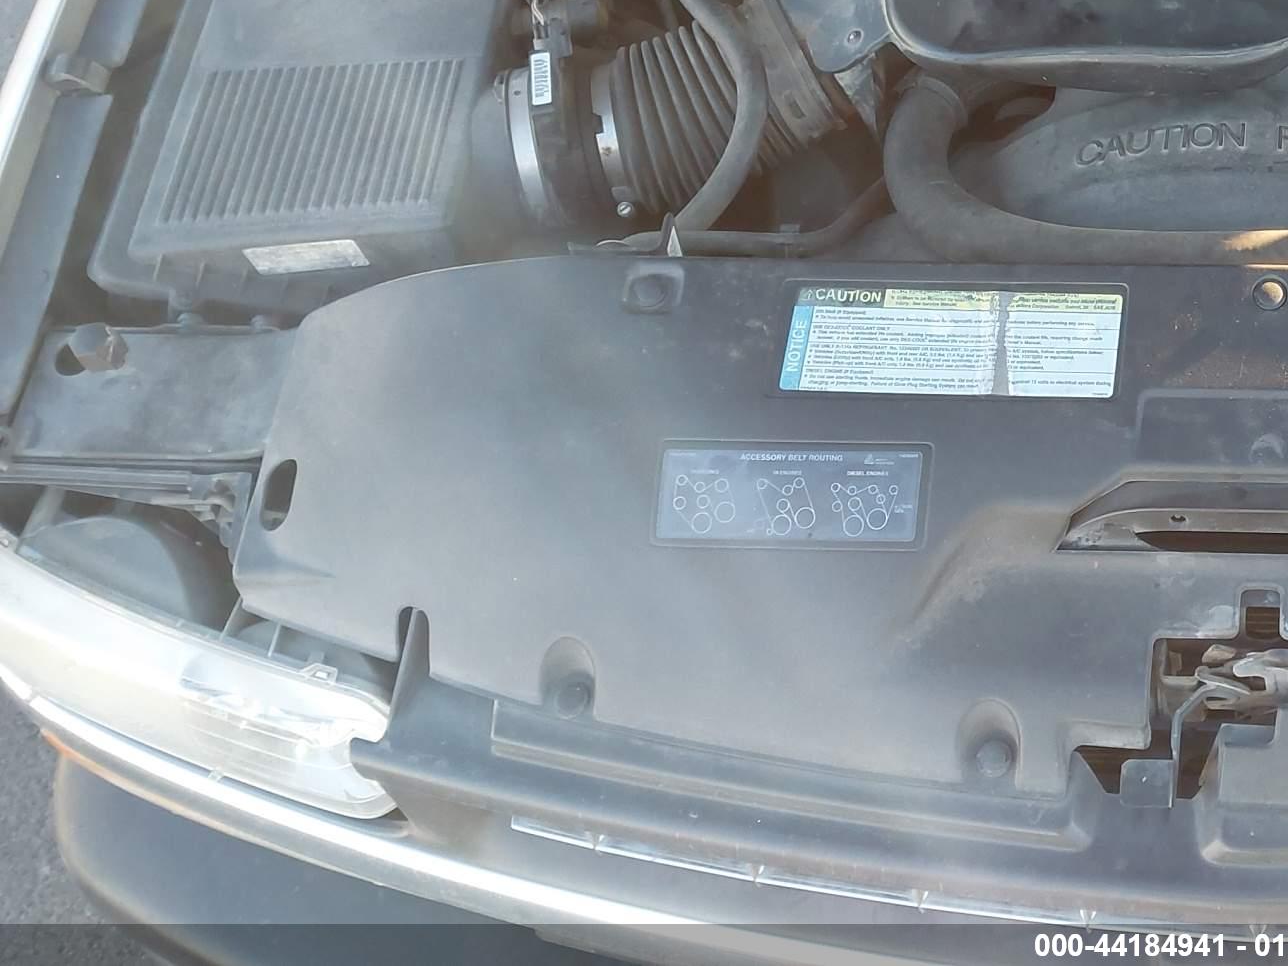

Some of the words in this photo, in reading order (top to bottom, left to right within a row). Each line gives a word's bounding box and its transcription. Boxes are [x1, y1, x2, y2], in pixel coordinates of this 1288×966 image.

[1075, 122, 1247, 167] CAUTION
[815, 288, 882, 303] CAUTION
[786, 319, 807, 372] NOTICE
[740, 453, 786, 462] ACCESSORY
[788, 454, 807, 462] BELT
[809, 454, 844, 462] ROUTING
